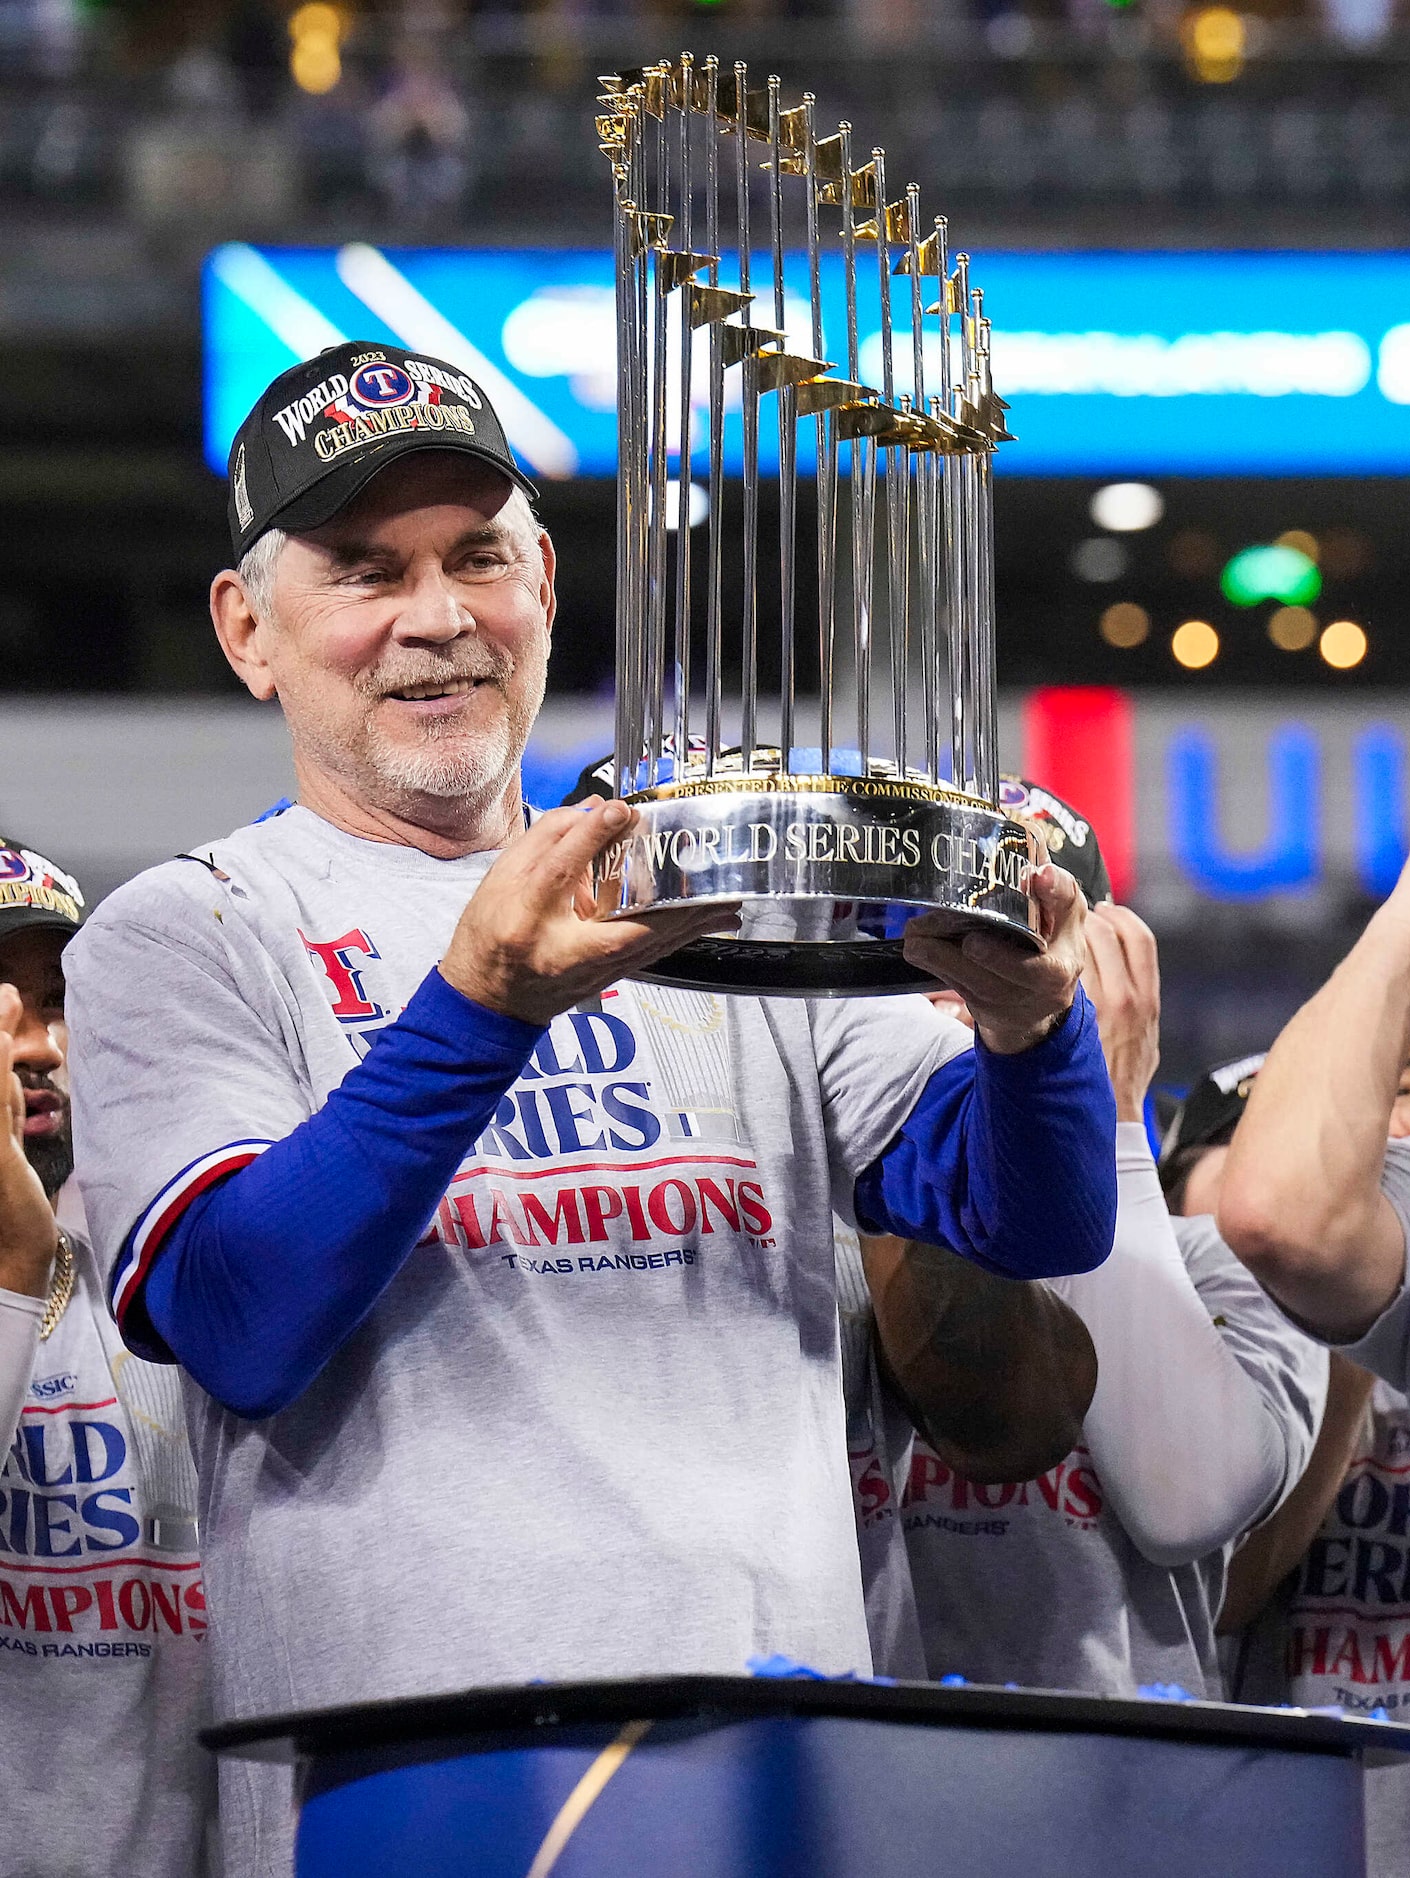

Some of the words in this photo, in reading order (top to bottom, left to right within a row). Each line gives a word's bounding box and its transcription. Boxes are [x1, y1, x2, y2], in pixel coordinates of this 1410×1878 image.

[351, 351, 387, 367] 2023
[364, 369, 398, 397] T
[272, 373, 349, 447] WORLD
[404, 360, 482, 410] SERIES
[314, 402, 475, 463] CHAMPIONS
[674, 778, 776, 799] PRESENTED
[781, 778, 799, 792] BY
[852, 781, 969, 807] COMMISSIONER
[641, 823, 777, 871] WORLD
[785, 822, 921, 868] SERIES
[297, 928, 381, 1023] T
[466, 1082, 661, 1160] RIES
[418, 1178, 772, 1250] HAMPIONS
[501, 1253, 574, 1275] TEXAS
[578, 1249, 694, 1273] RANGERS
[0, 1577, 208, 1636] MPIONS
[0, 1636, 38, 1657] XAS
[42, 1641, 152, 1659] RANGERS
